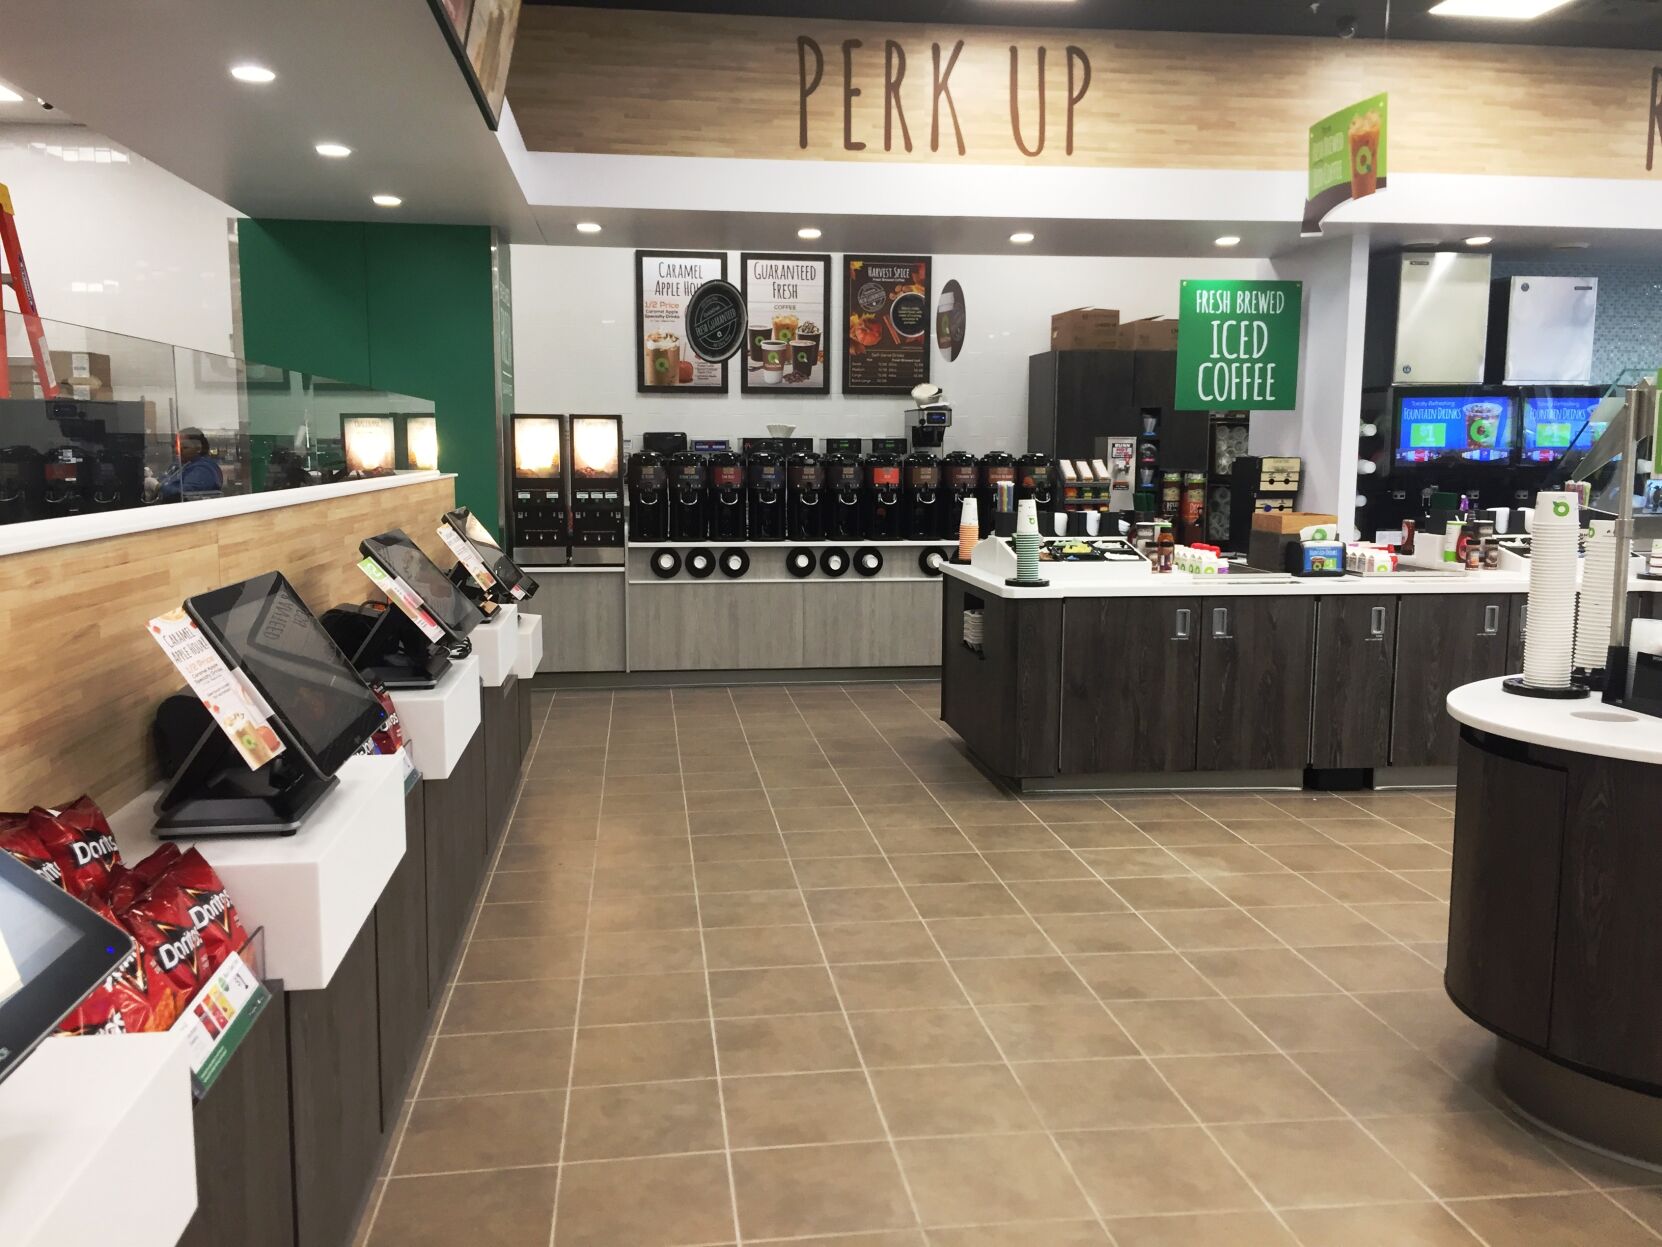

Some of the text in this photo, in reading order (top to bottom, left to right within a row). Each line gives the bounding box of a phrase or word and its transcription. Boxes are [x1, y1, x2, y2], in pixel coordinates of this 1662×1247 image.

[797, 35, 1092, 156] PERK UP
[658, 262, 703, 279] CARAMEL
[753, 261, 816, 281] GUARANTEED
[867, 266, 910, 278] HARVEST SPICE
[654, 280, 680, 296] APPLE
[772, 281, 798, 299] FRESH
[660, 301, 680, 309] Price
[1195, 290, 1285, 314] FRESH BREWED
[1209, 320, 1268, 359] ICED
[1197, 361, 1276, 401] COFFEE
[1403, 408, 1462, 420] FOUNTAIN DRINKS
[162, 626, 196, 648] CARAMEL
[188, 888, 232, 931] Doritos
[158, 926, 203, 970] Doritos
